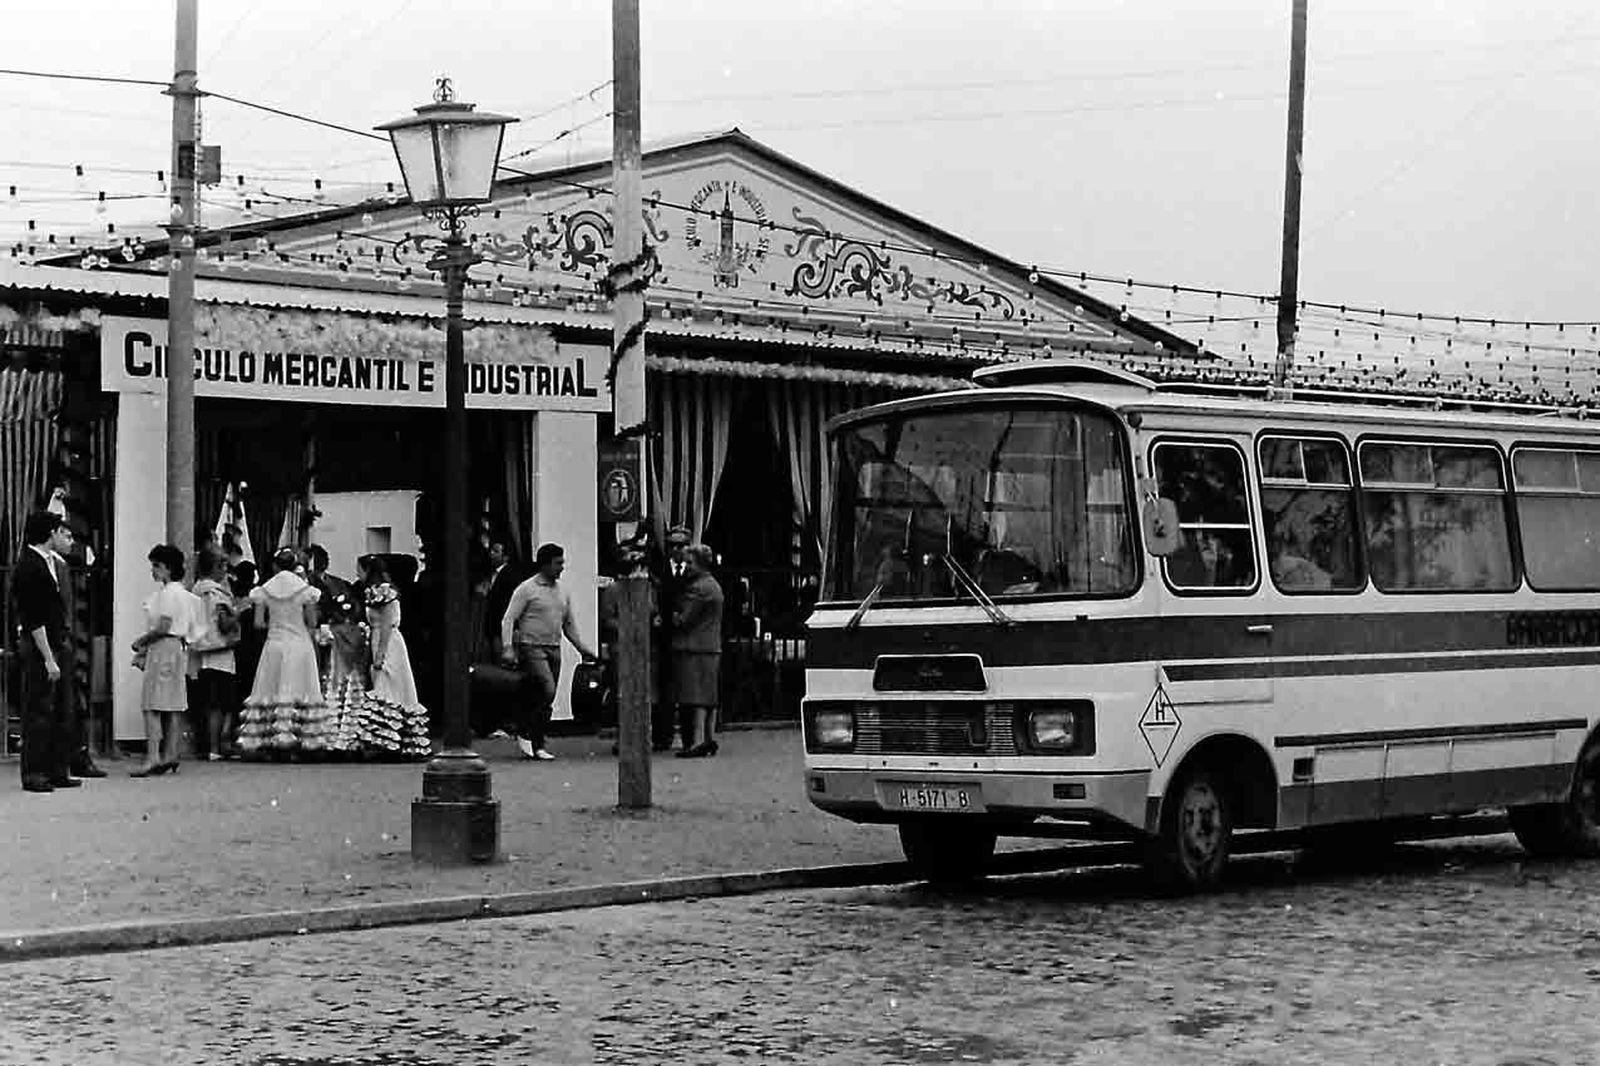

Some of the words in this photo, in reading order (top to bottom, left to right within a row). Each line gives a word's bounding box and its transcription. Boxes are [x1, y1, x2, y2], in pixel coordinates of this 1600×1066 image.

[124, 332, 256, 383] CIULO
[263, 353, 410, 391] MERCANTIL
[418, 361, 434, 392] E
[464, 357, 598, 397] DUSTRIAL
[1156, 701, 1165, 720] H
